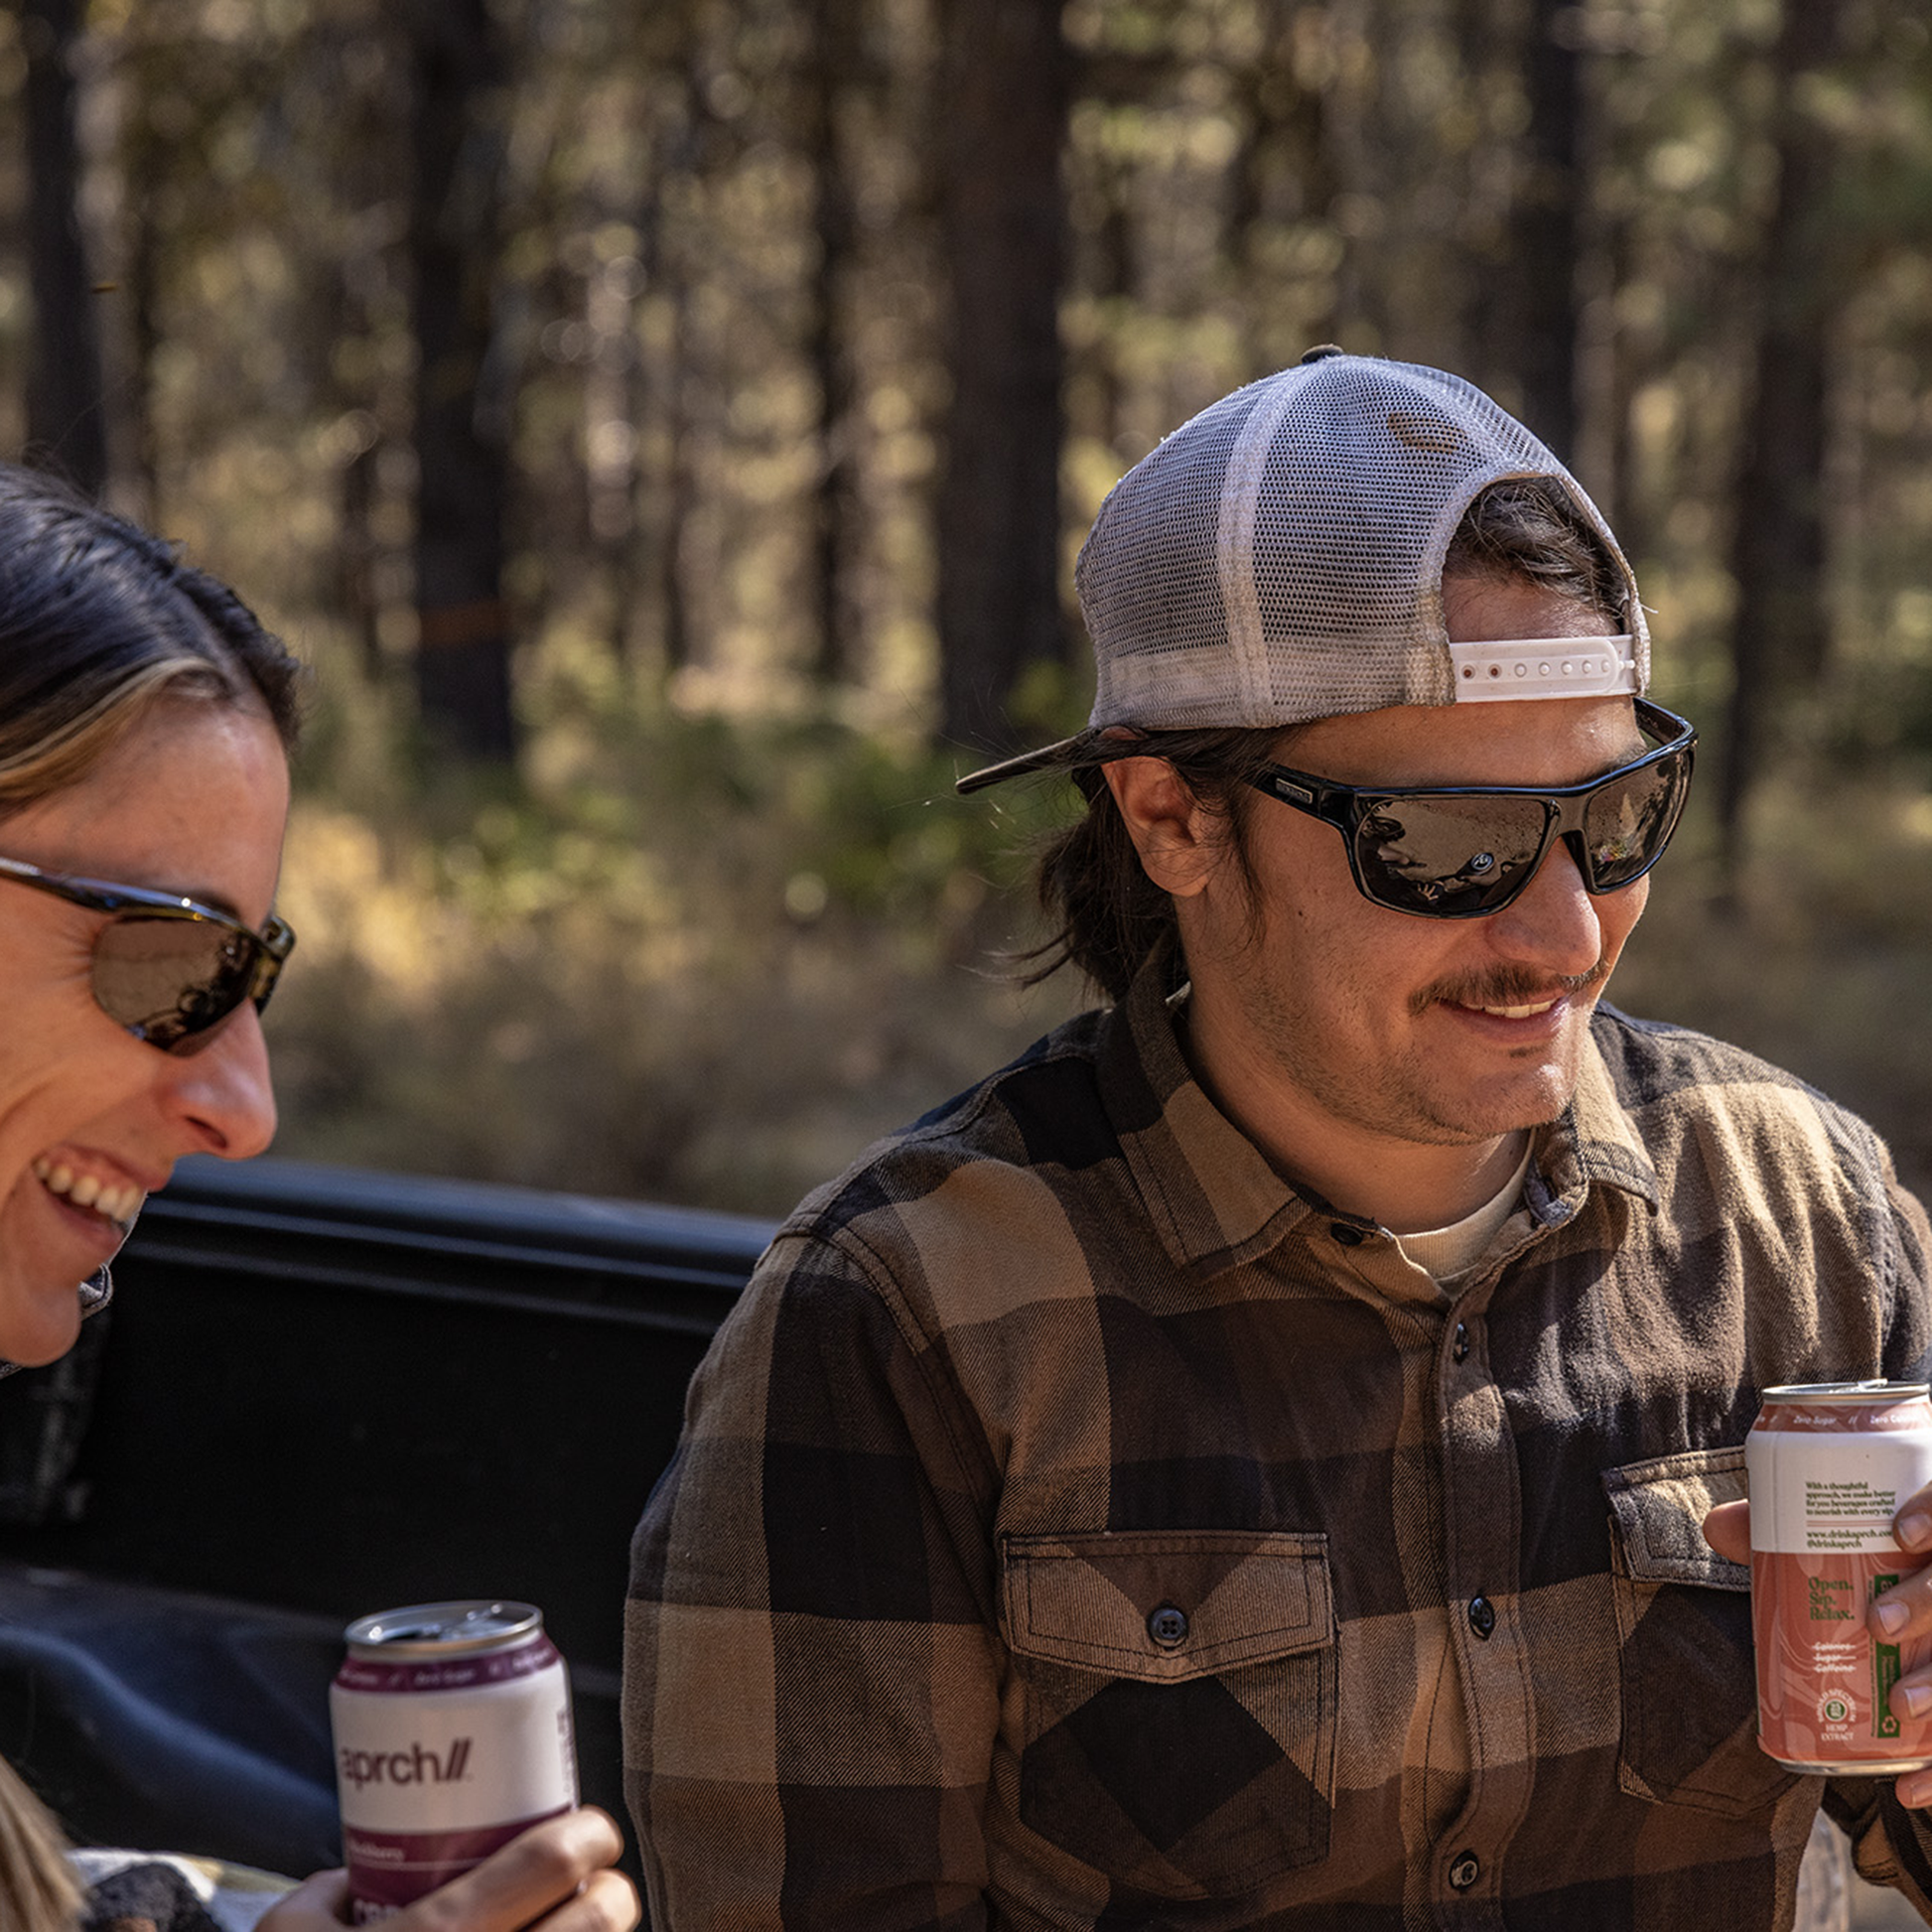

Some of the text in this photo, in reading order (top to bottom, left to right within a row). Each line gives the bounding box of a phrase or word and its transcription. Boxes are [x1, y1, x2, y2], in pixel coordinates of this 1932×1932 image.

[1793, 1415, 1812, 1425] Zero
[1813, 1415, 1837, 1427] Sugar
[1829, 1481, 1868, 1491] thoughtful
[1831, 1499, 1867, 1508] beverages
[1861, 1508, 1880, 1517] every
[1808, 1576, 1855, 1594] Open.
[1809, 1591, 1836, 1609] Sip.
[1810, 1606, 1856, 1620] Relax.
[1825, 1724, 1848, 1732] HEMP
[1820, 1731, 1855, 1741] EXTRACT
